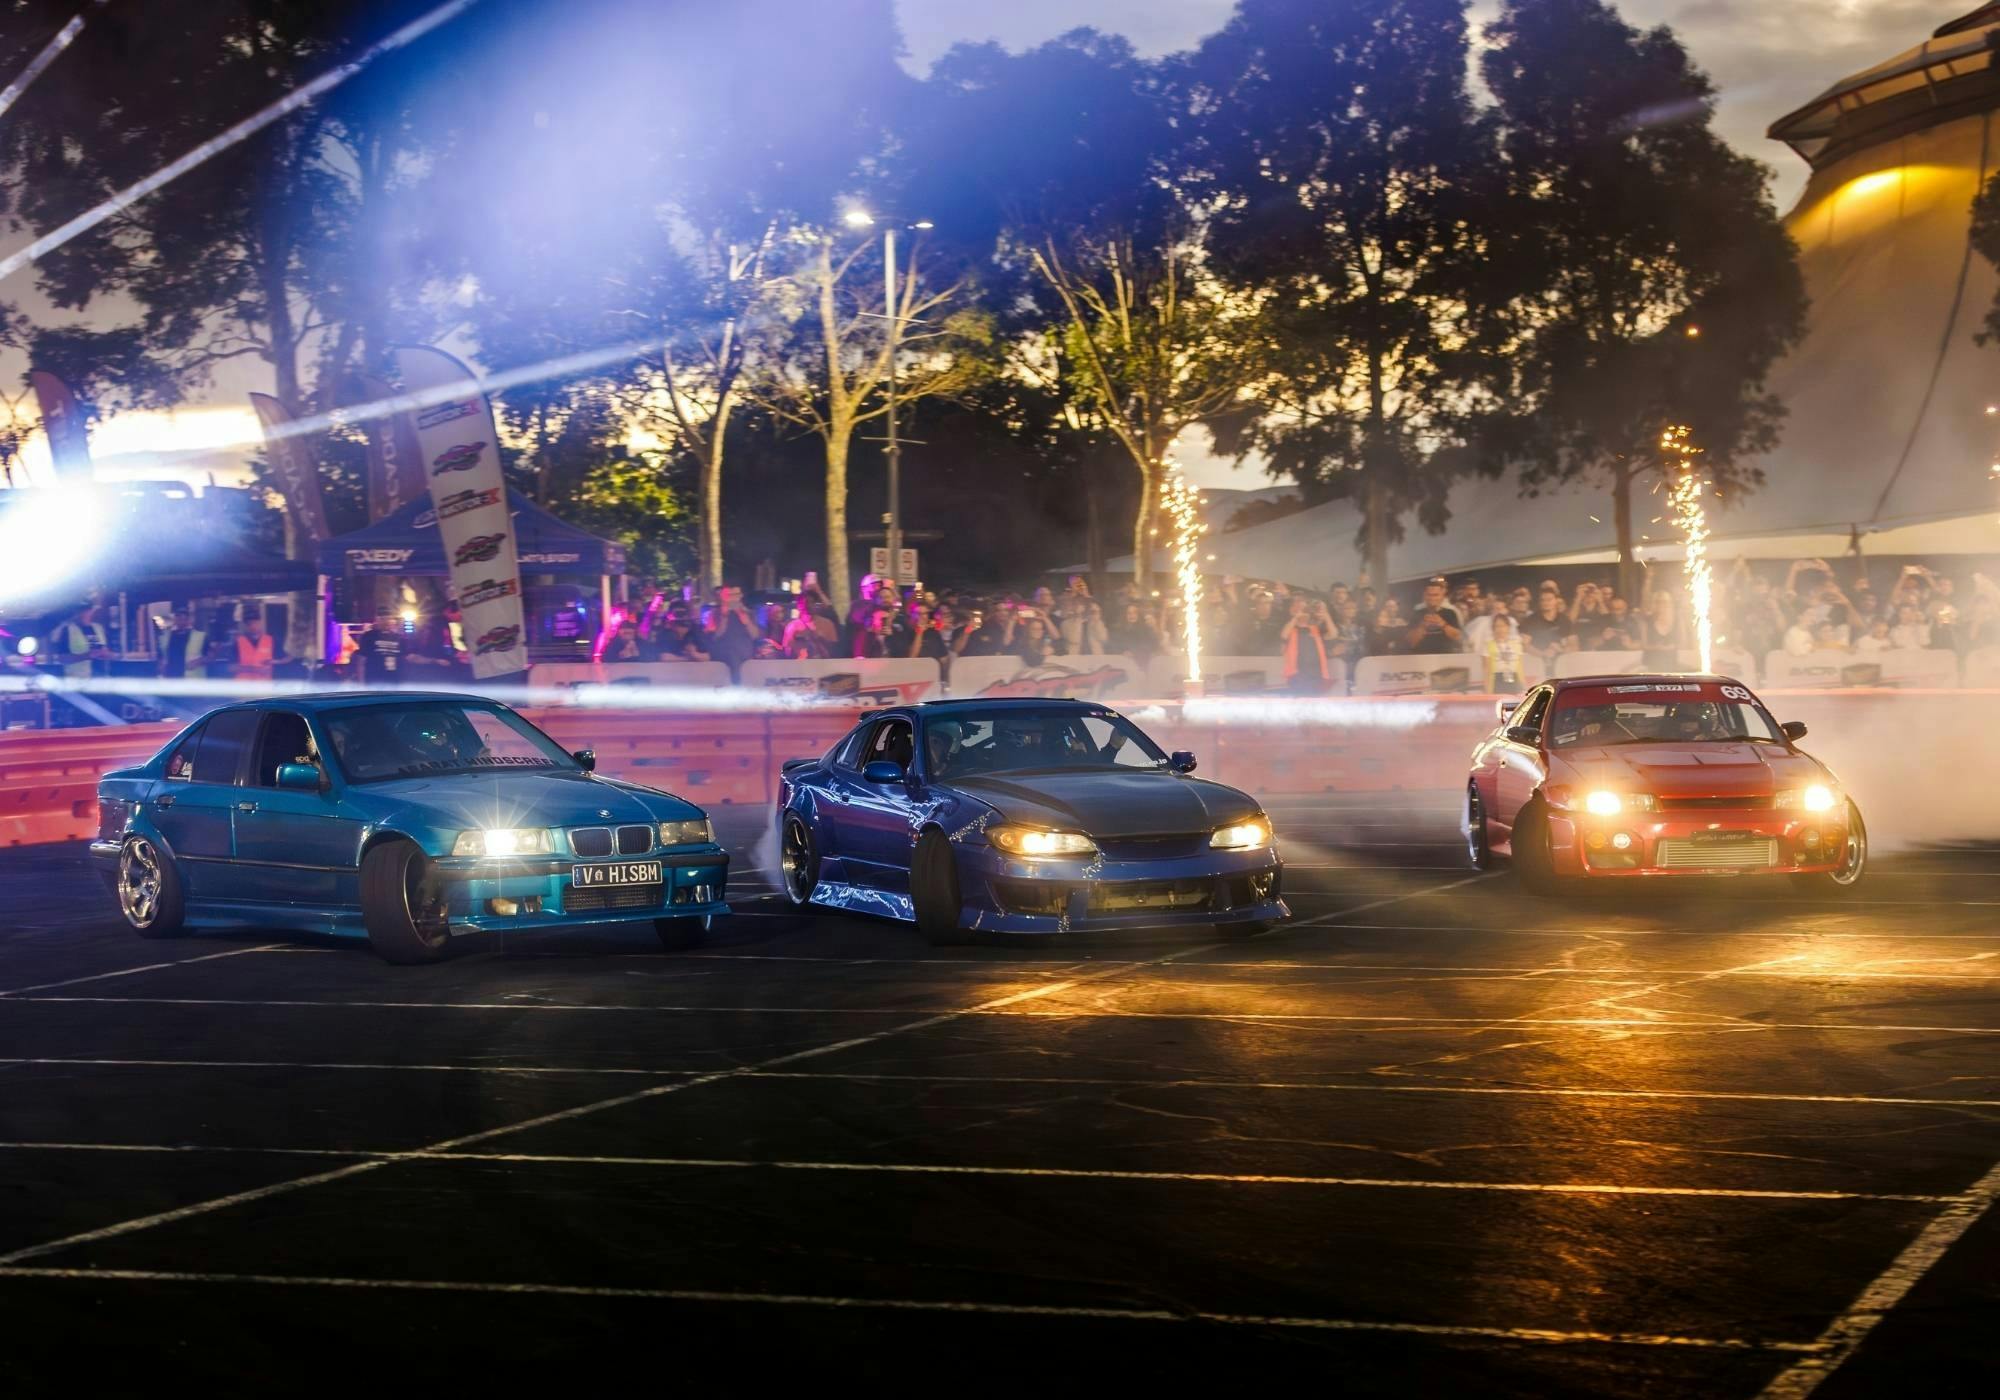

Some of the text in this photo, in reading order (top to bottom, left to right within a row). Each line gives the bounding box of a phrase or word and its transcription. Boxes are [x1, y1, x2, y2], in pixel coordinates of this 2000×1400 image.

[345, 549, 415, 565] EXEDY
[1720, 685, 1751, 700] 69
[609, 864, 658, 883] HISBM
